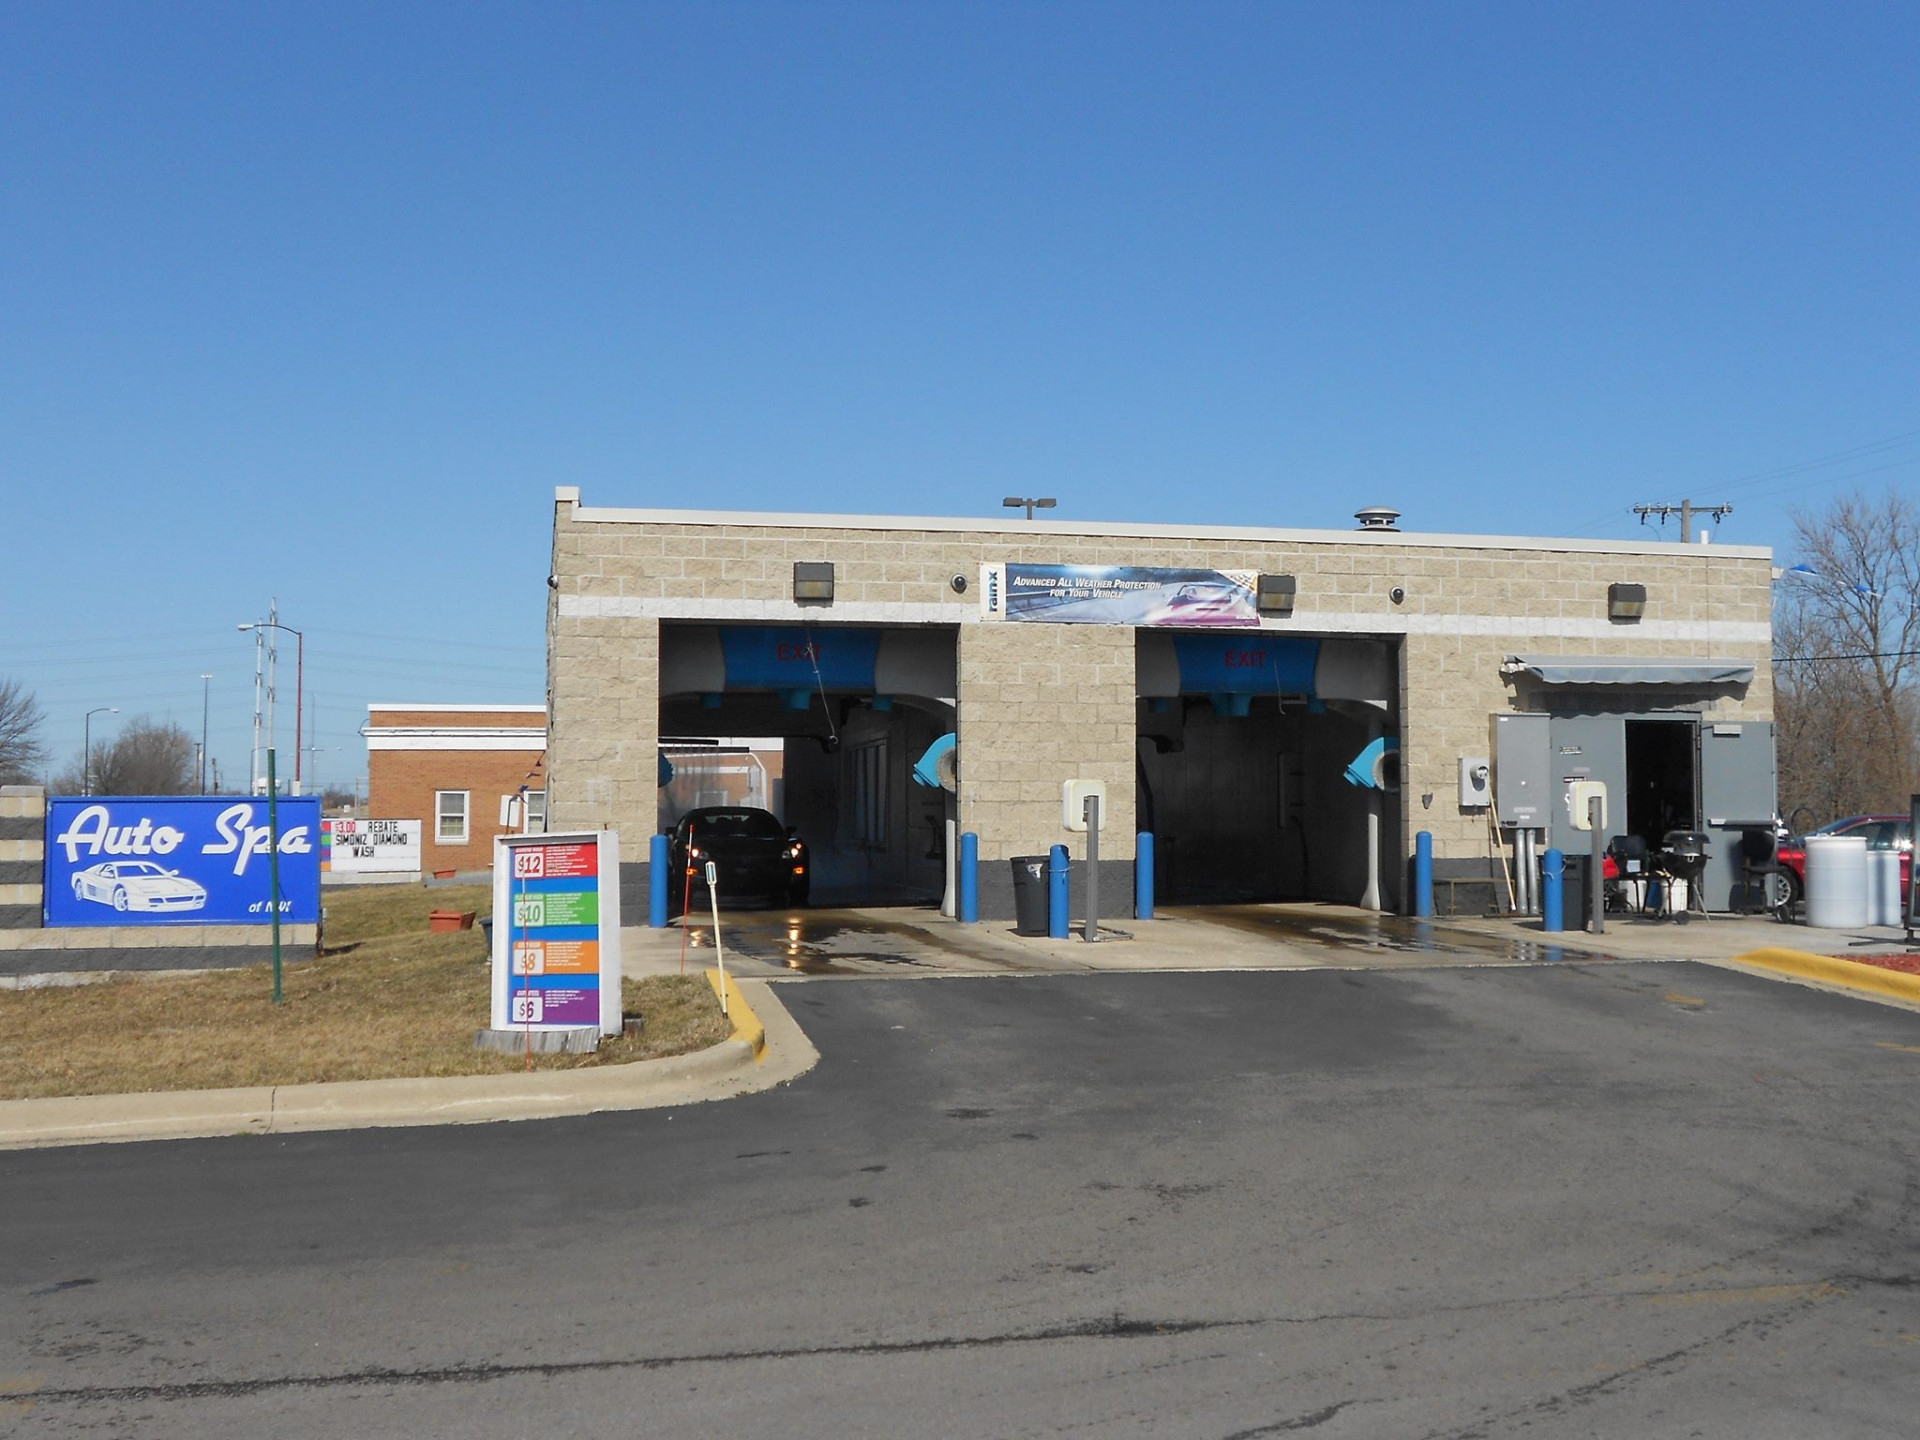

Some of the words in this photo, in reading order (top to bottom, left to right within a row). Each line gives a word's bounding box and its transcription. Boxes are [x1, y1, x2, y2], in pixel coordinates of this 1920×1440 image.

[1013, 576, 1056, 587] ADVANCED
[1057, 577, 1073, 587] ALL
[1075, 578, 1112, 588] WEATHER
[1114, 579, 1162, 590] PROTECTION
[1049, 588, 1066, 597] FOR
[1069, 588, 1089, 598] YOUR
[1092, 589, 1125, 599] VEHICLE
[777, 644, 823, 661] EXIT
[1224, 648, 1267, 667] EXIT
[367, 821, 399, 833] REBATE
[56, 805, 185, 864] Auto
[201, 803, 312, 876] Spa
[335, 833, 367, 846] SIMONIZ
[372, 833, 408, 846] DIAMOND
[352, 846, 375, 858] WASH
[518, 855, 541, 873] $12
[248, 899, 263, 913] of
[518, 905, 541, 922] $10
[521, 953, 536, 970] $8
[519, 1001, 534, 1019] $6
